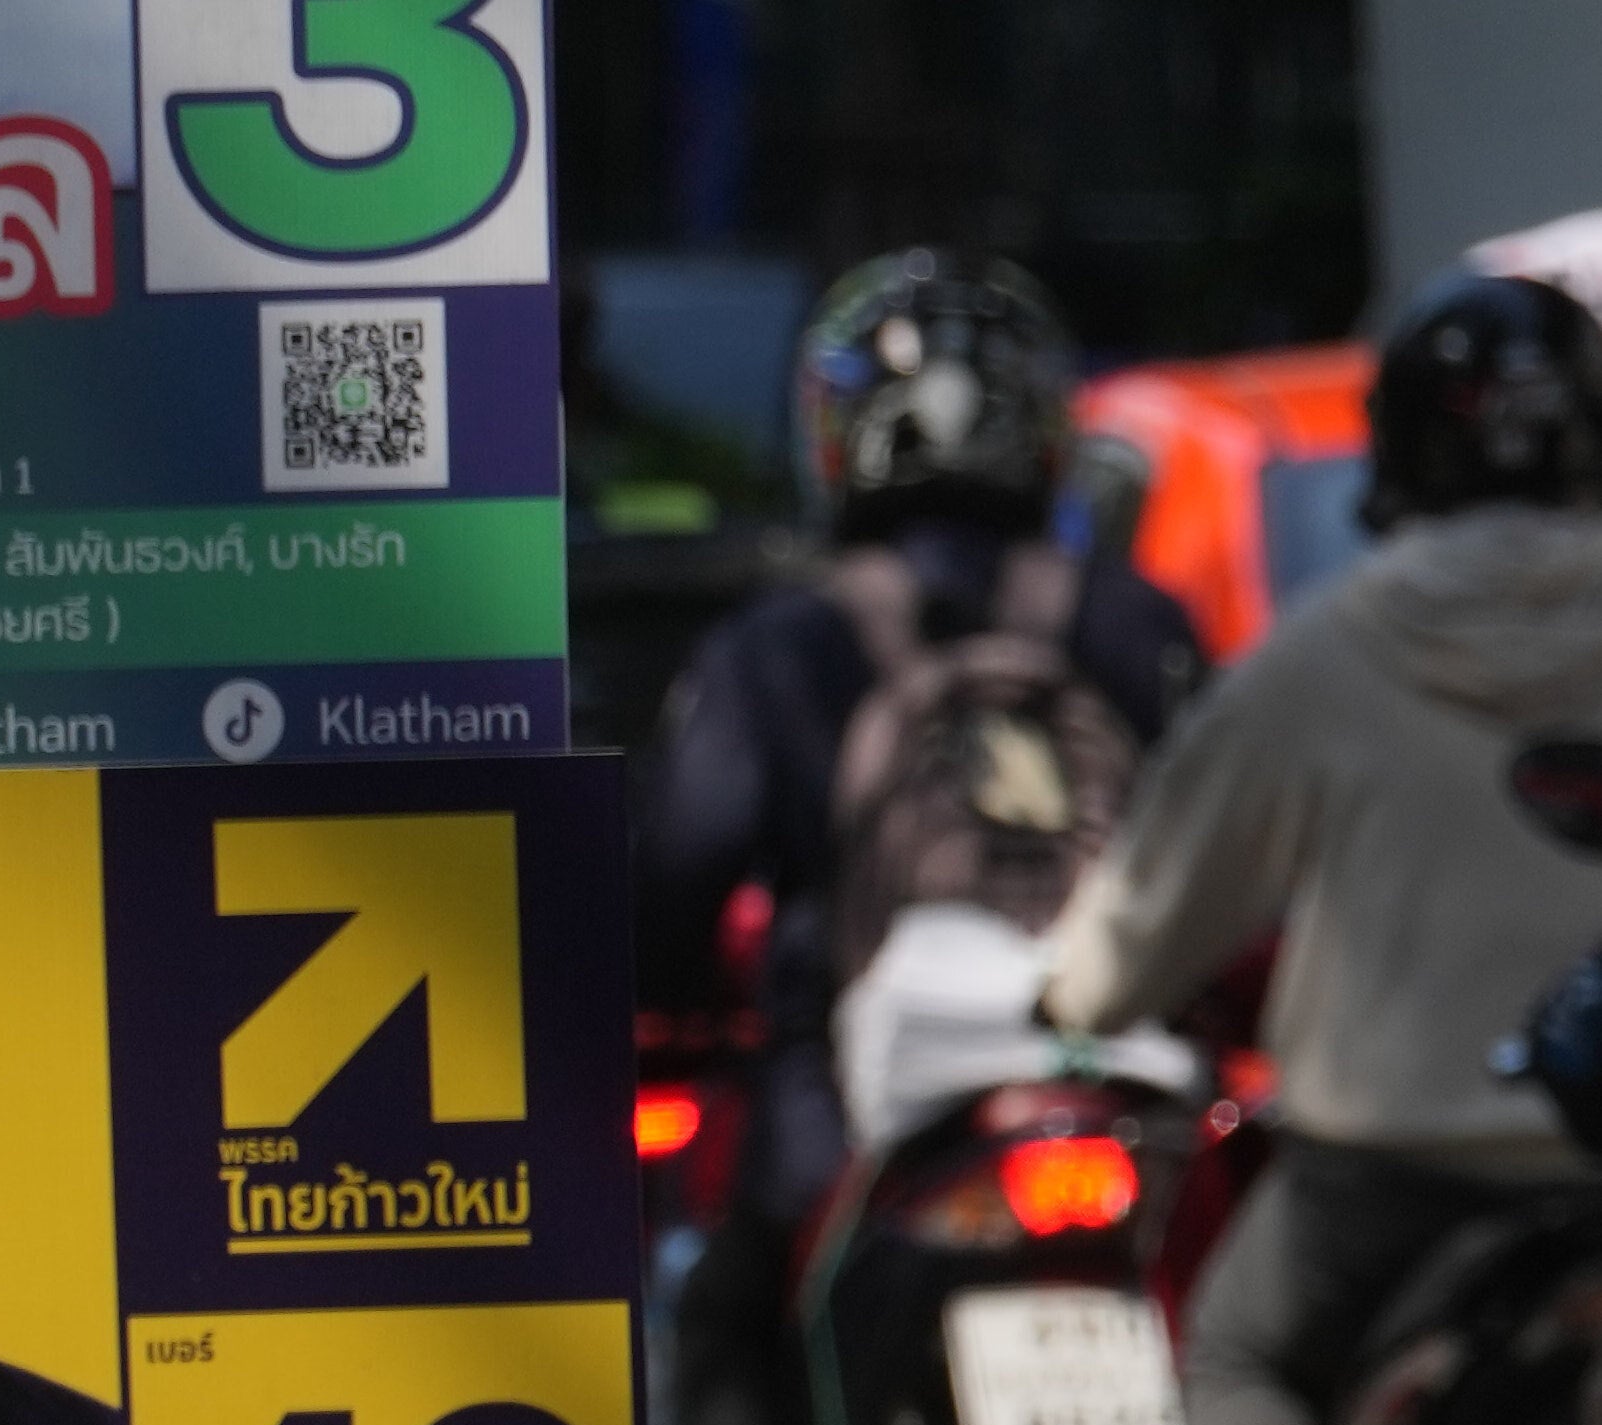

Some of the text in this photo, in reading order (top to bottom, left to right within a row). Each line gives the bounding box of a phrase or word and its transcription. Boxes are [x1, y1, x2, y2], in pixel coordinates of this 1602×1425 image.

[14, 456, 35, 496] 1
[5, 522, 255, 578] สัมพันธวงศ์,
[268, 519, 406, 572] บางรัก
[318, 695, 532, 746] Klatham
[219, 1137, 298, 1166] พรรค
[221, 1161, 530, 1236] ไทยก้าวใหม่
[145, 1328, 215, 1365] เบอร์
